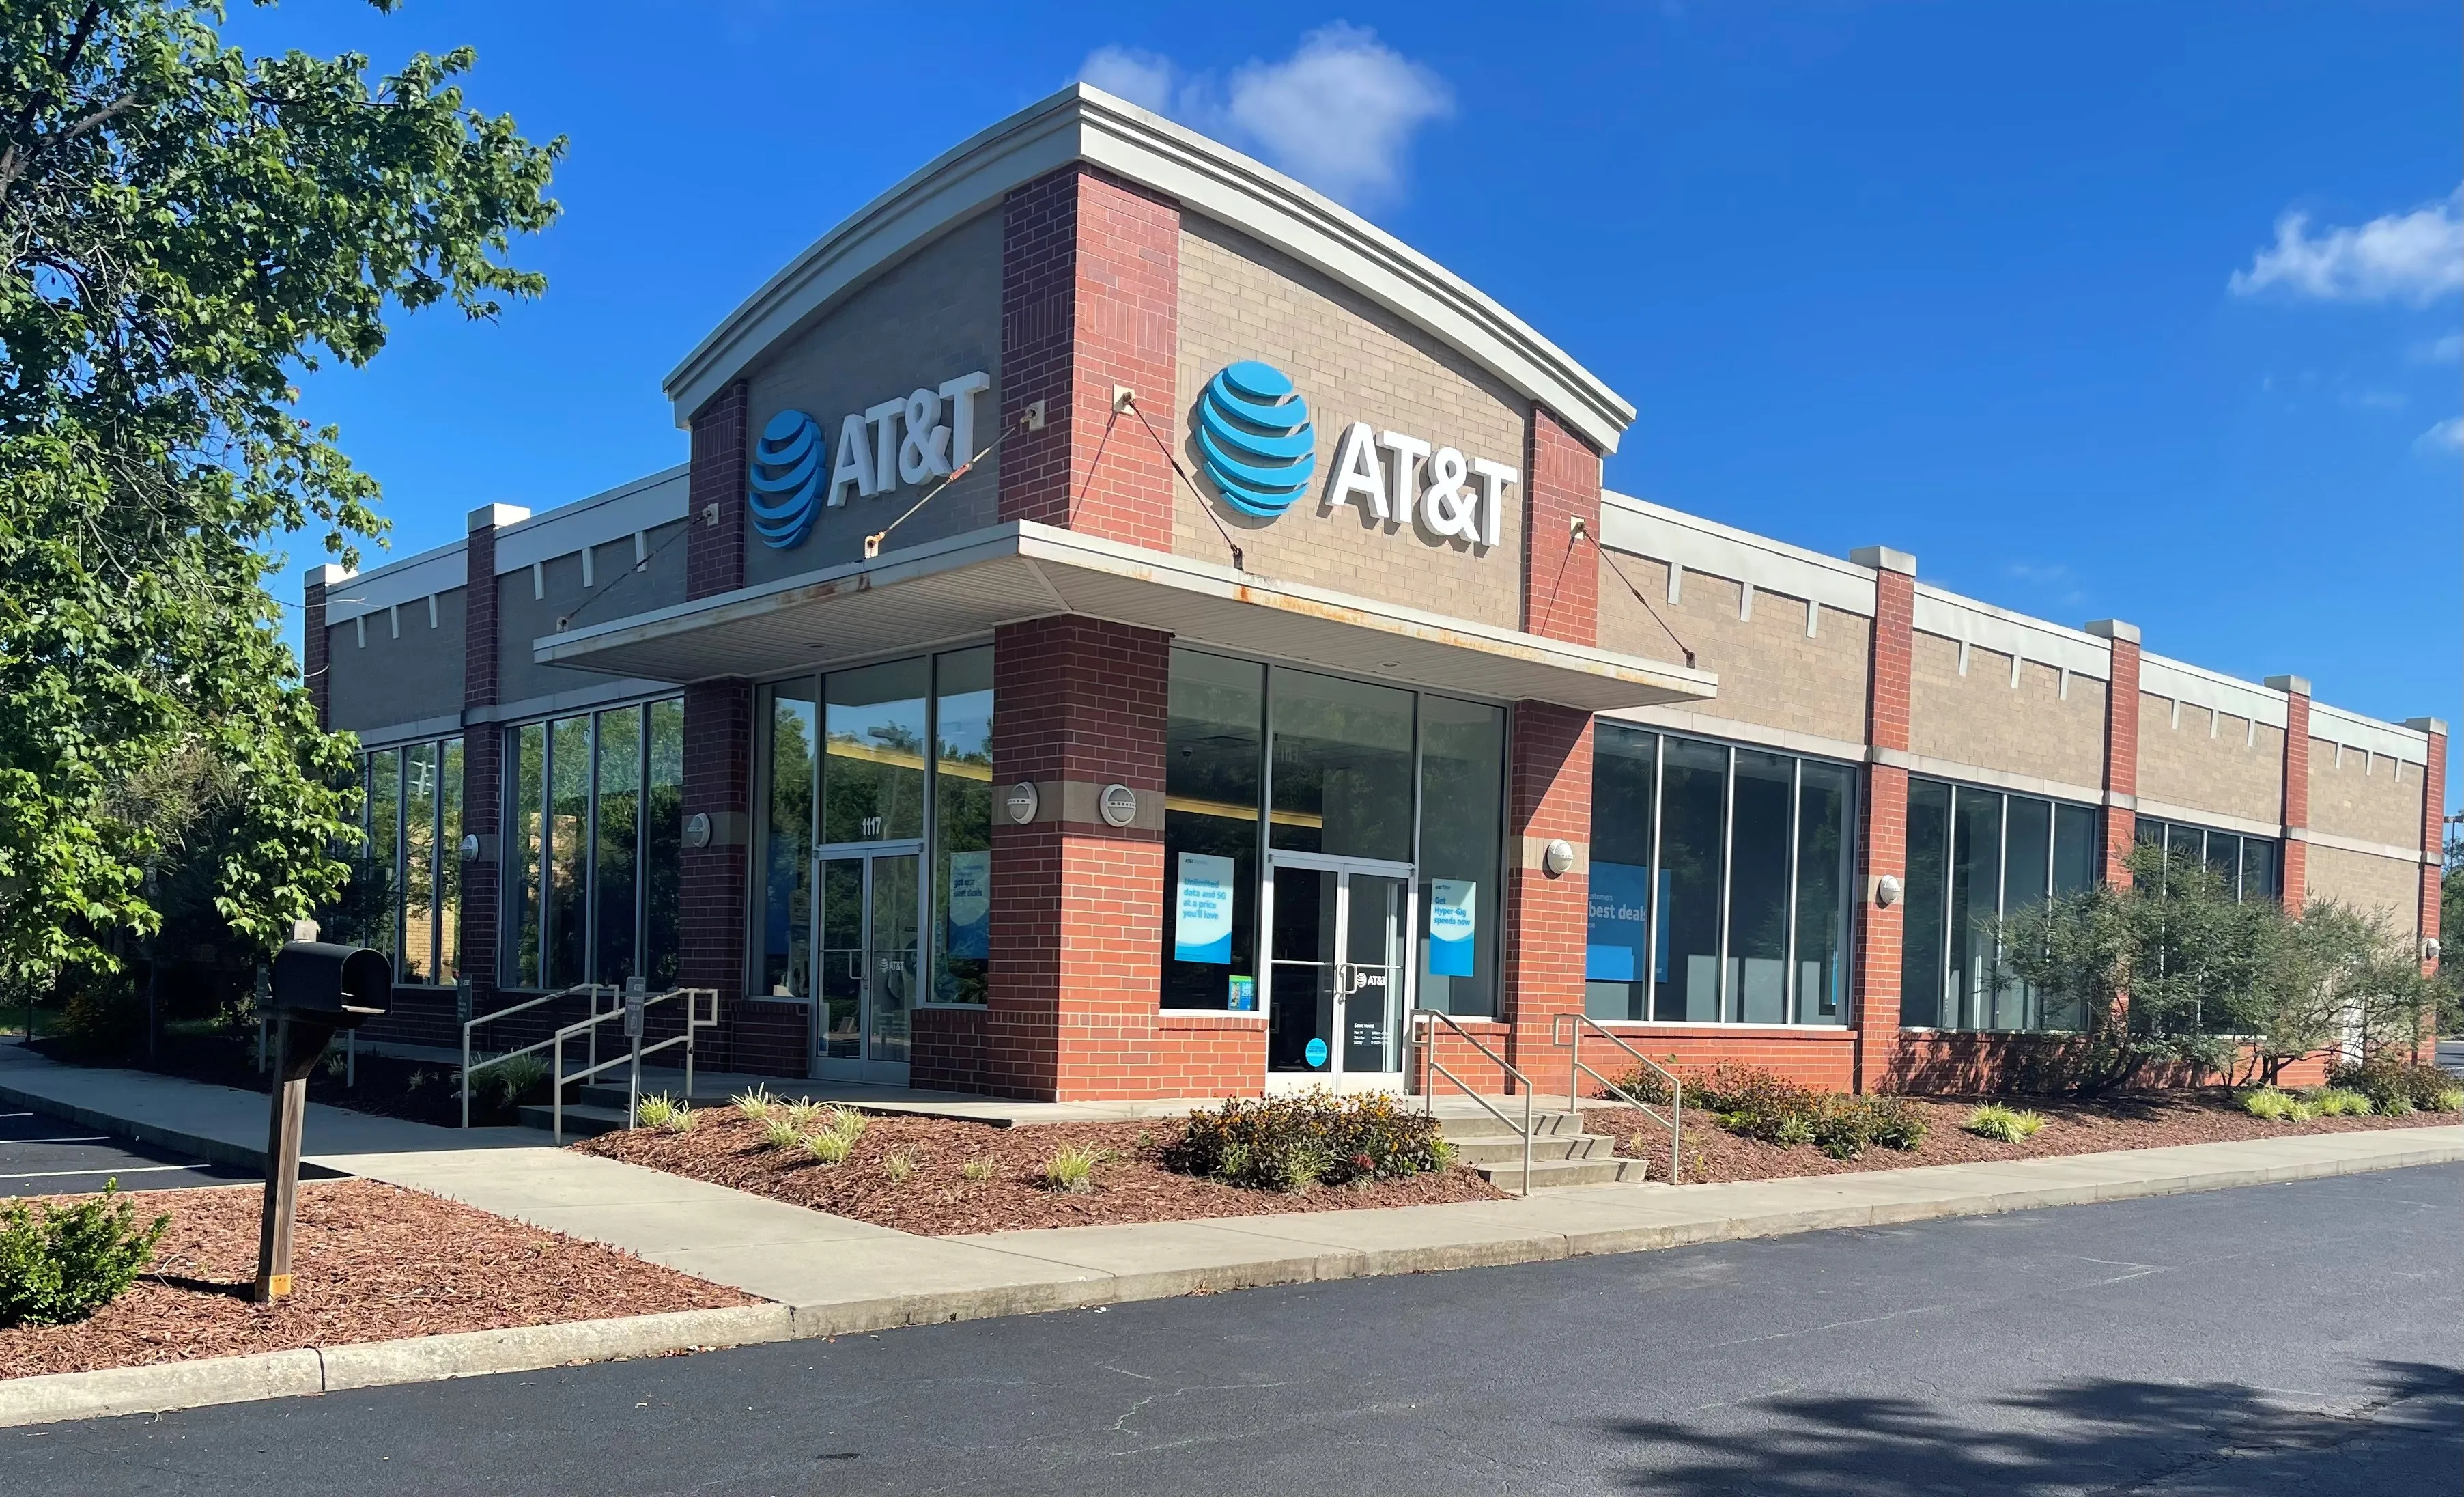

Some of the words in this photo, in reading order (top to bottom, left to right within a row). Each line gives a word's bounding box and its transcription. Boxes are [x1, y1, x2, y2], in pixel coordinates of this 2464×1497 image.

[827, 371, 990, 507] AT&T
[1325, 421, 1518, 546] AT&T
[863, 817, 881, 836] 1117
[1184, 877, 1219, 888] Unlimited
[1183, 888, 1200, 897] data
[1202, 891, 1215, 899] and
[1217, 891, 1226, 899] 5G
[1589, 893, 1613, 901] ustomers
[1198, 901, 1217, 910] price
[1434, 896, 1447, 904] Get
[1183, 910, 1202, 919] you'll
[1204, 910, 1219, 919] love
[1434, 906, 1467, 918] Hyper-Gig
[1588, 901, 1616, 919] best
[1434, 917, 1456, 925] speeds
[889, 961, 905, 971] AT&T
[1367, 975, 1387, 986] AT&T
